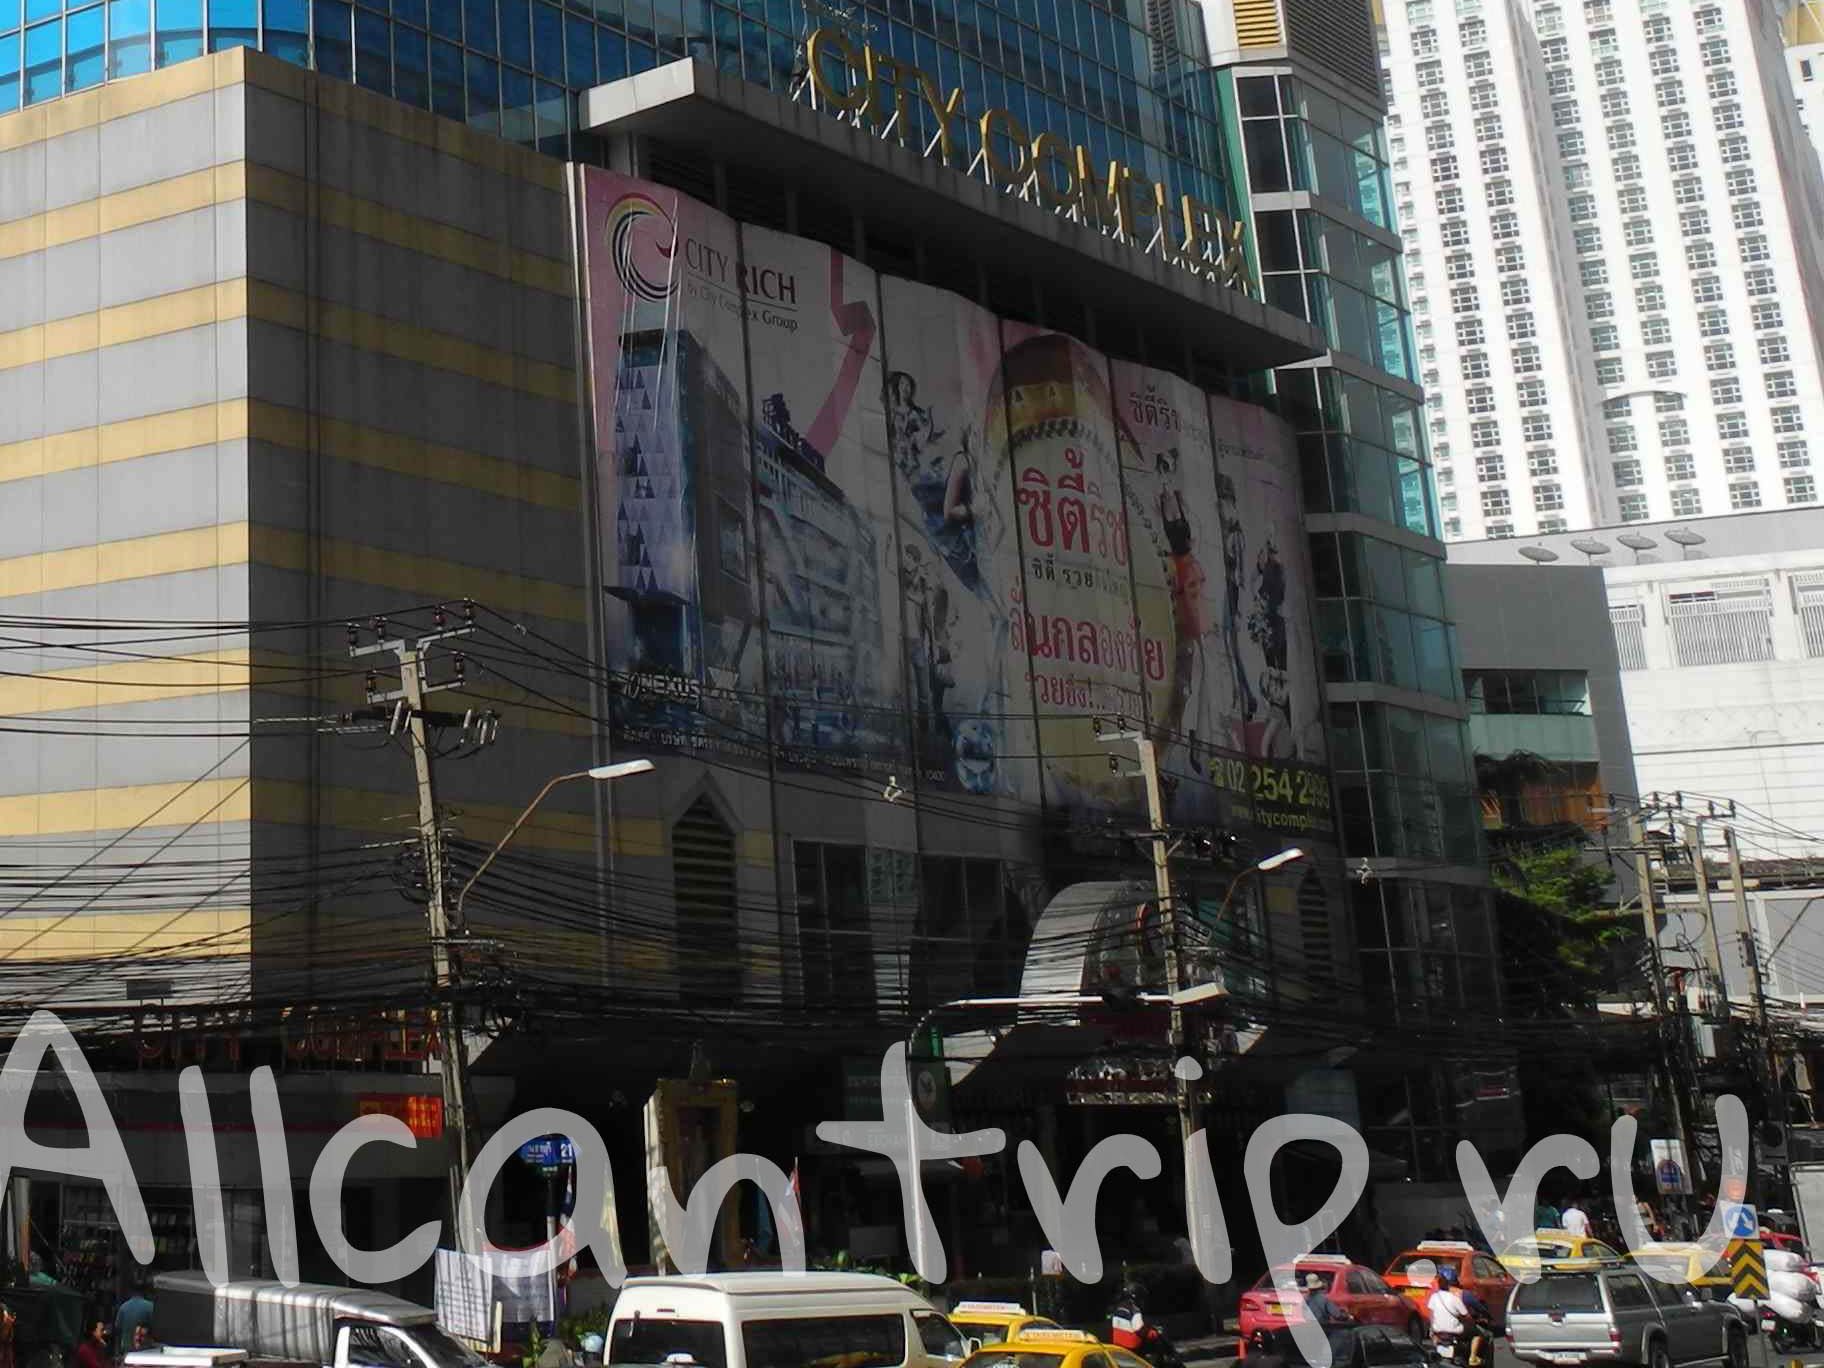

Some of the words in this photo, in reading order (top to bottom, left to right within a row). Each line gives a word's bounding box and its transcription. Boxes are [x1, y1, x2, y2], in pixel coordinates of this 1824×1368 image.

[805, 28, 962, 154] CITY
[686, 237, 728, 283] CITY
[1251, 764, 1293, 804] 254
